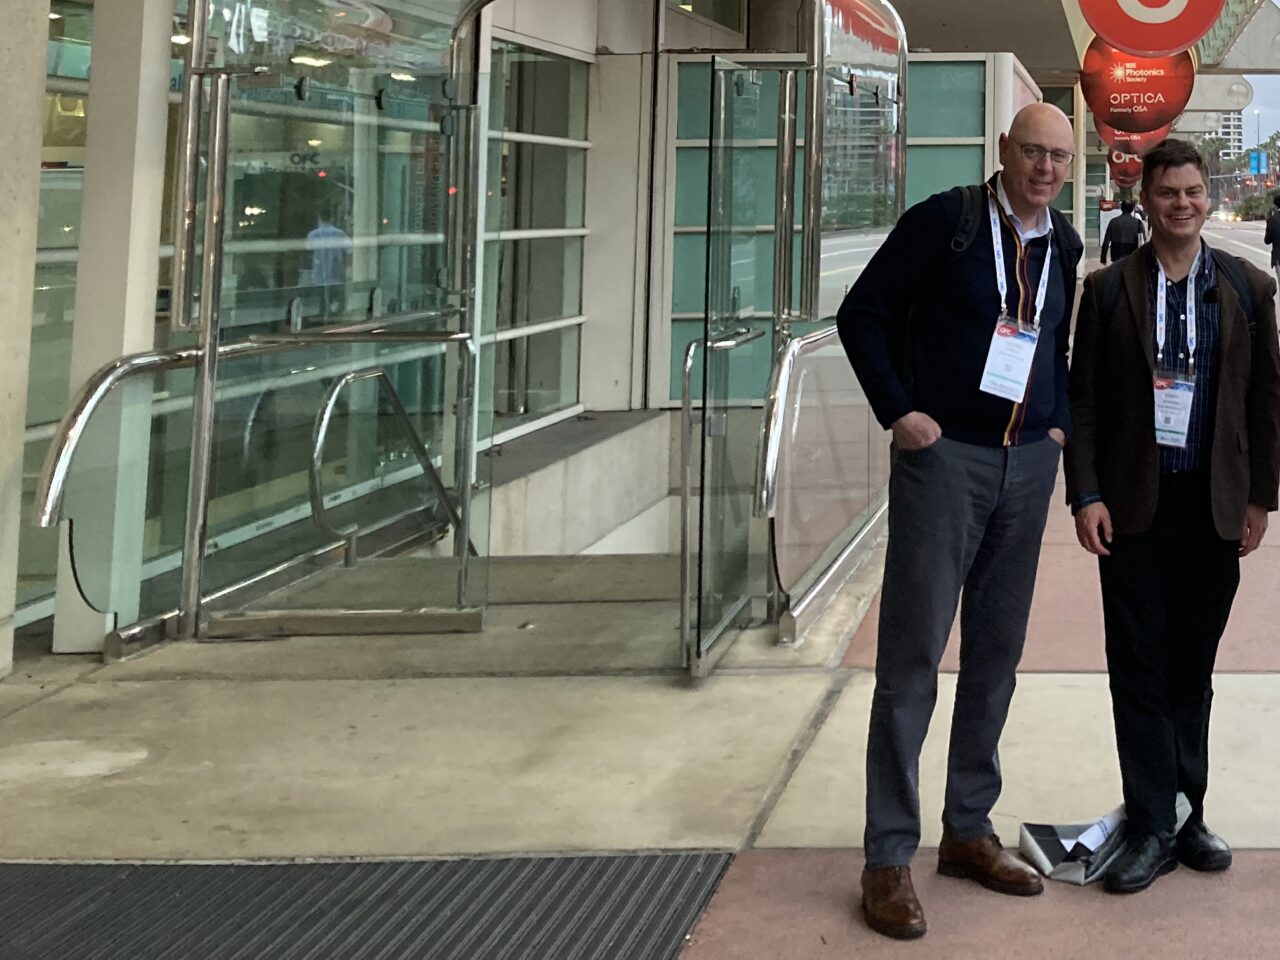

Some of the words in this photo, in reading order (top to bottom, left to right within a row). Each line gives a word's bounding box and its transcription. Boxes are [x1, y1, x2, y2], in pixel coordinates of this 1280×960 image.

[1125, 67, 1165, 76] Photonics
[1109, 92, 1165, 105] OPTICA
[1132, 105, 1148, 113] OSA
[290, 152, 321, 165] OFC
